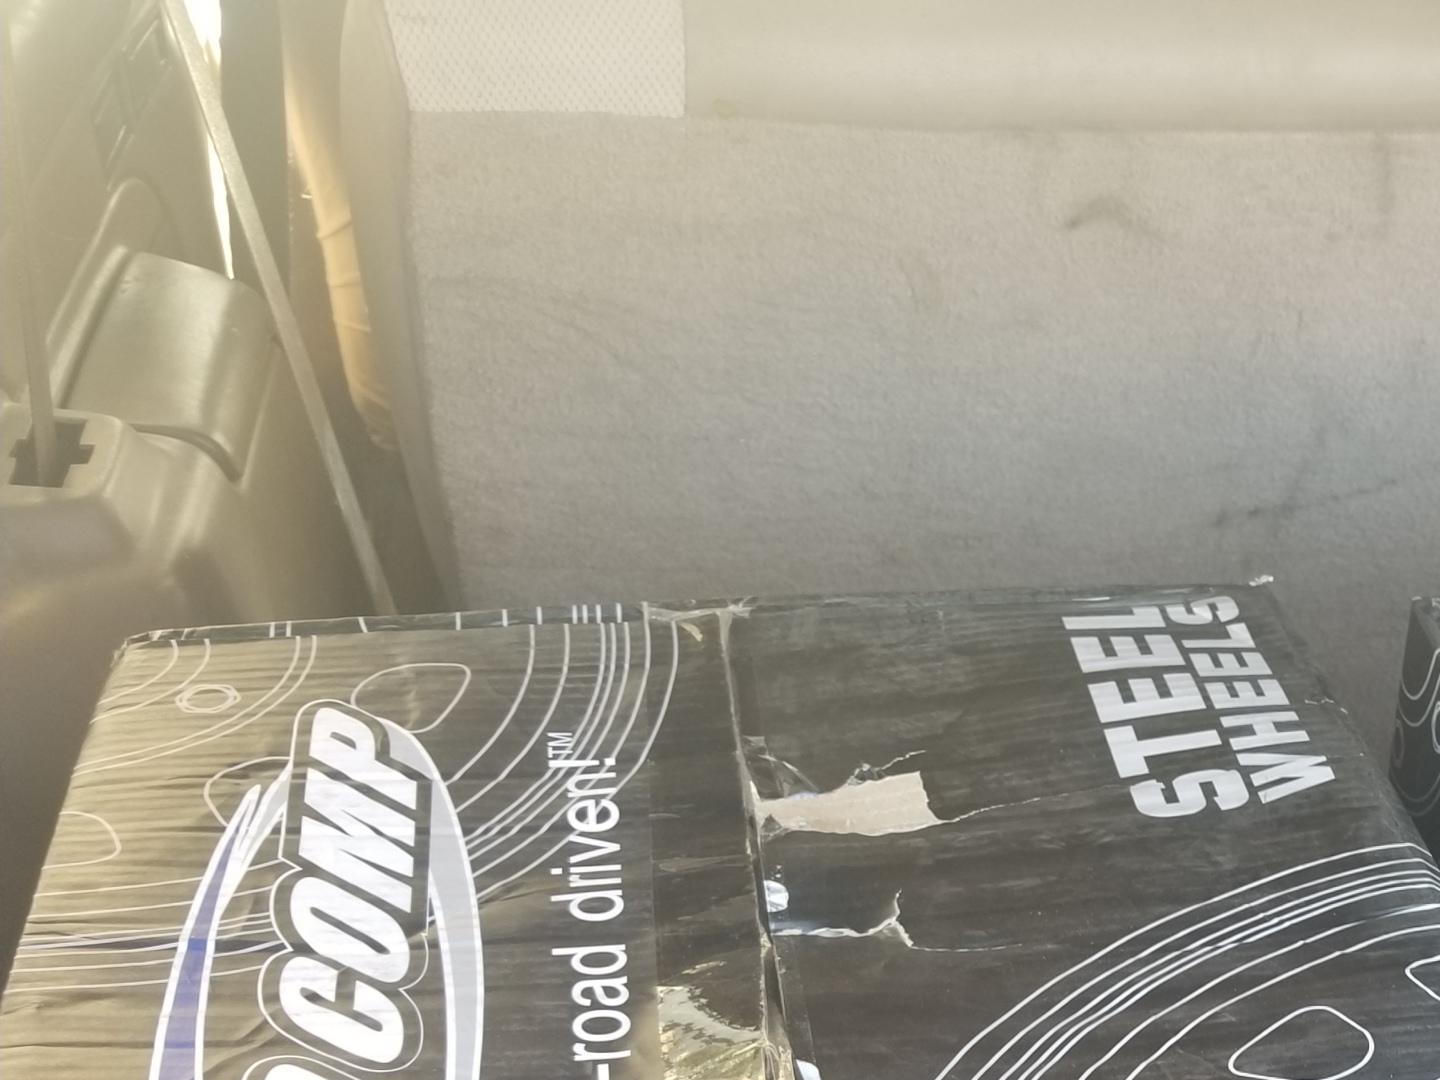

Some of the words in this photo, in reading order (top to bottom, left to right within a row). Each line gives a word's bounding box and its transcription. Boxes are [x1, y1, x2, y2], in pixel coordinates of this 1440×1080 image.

[1061, 605, 1250, 818] STEEL
[1164, 595, 1336, 804] WHEELS
[278, 705, 419, 1065] COMP
